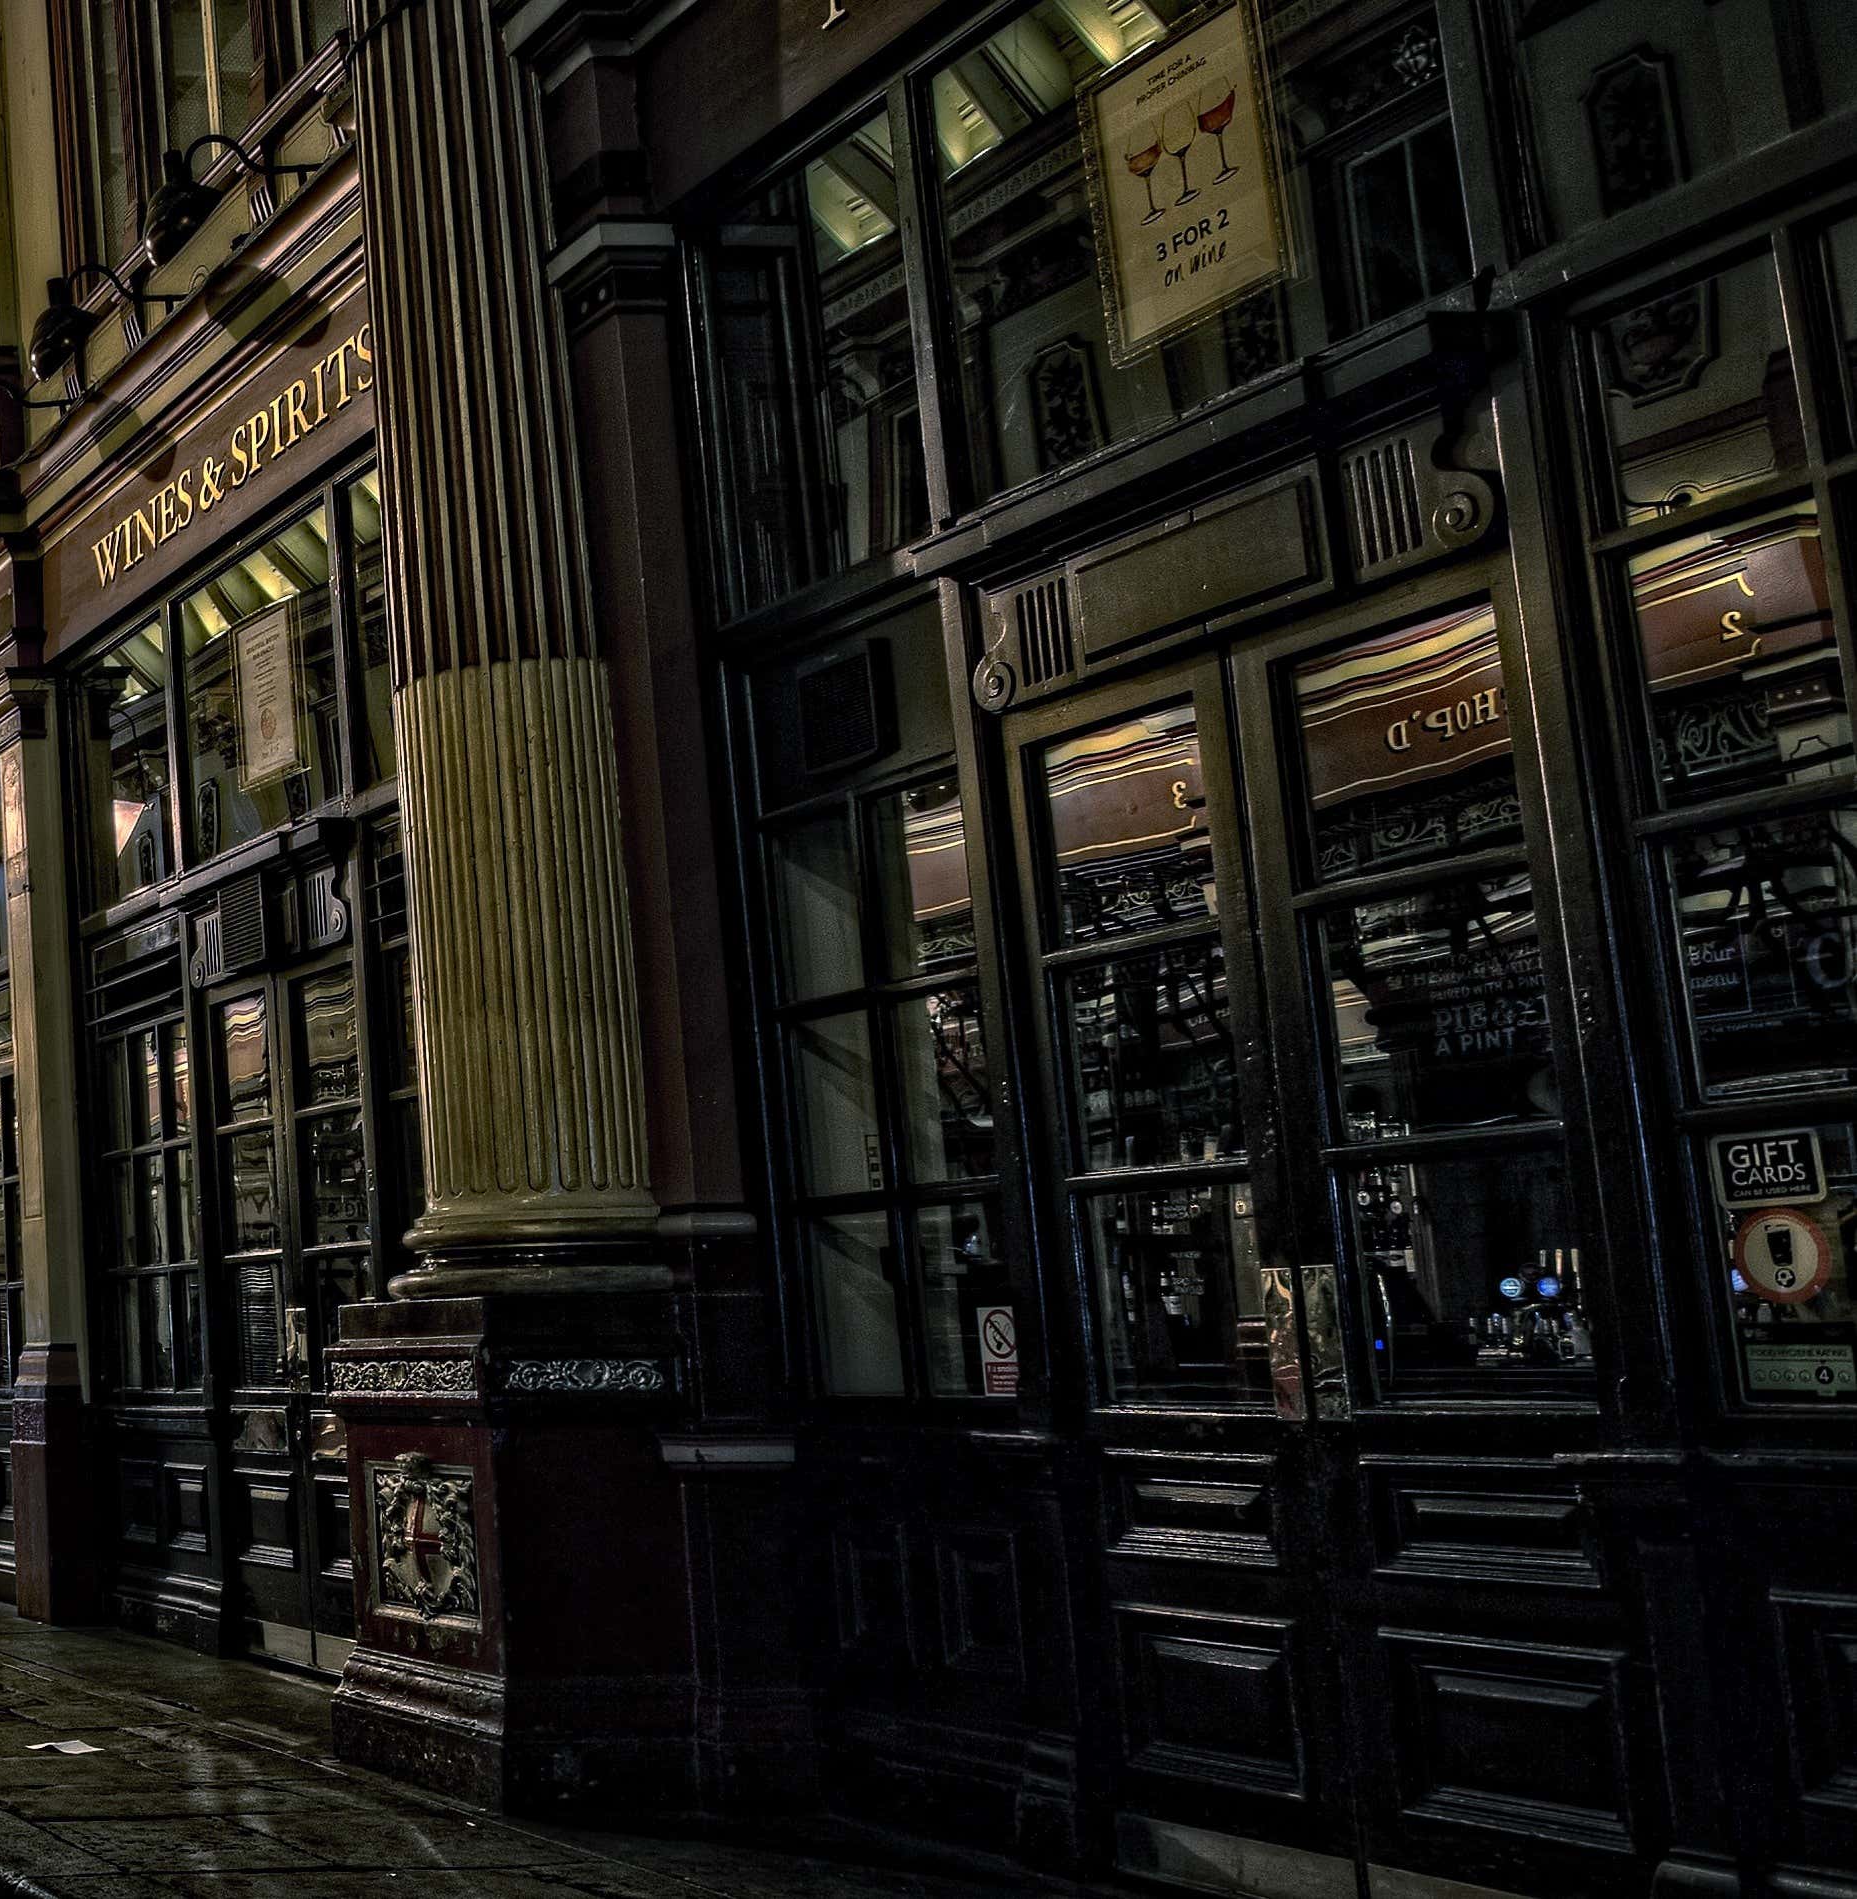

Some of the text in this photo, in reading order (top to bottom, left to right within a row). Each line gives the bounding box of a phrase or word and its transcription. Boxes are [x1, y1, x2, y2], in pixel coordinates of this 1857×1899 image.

[1147, 70, 1166, 85] TIME
[1167, 58, 1183, 74] FOR
[1156, 209, 1230, 262] 3 FOR 2
[1164, 240, 1227, 287] on wine
[91, 323, 374, 588] WINES & SPIRITS
[1459, 1027, 1516, 1052] PINT
[1727, 1139, 1800, 1169] GIFT
[1731, 1163, 1806, 1187] CARDS
[1819, 1368, 1830, 1382] 4
